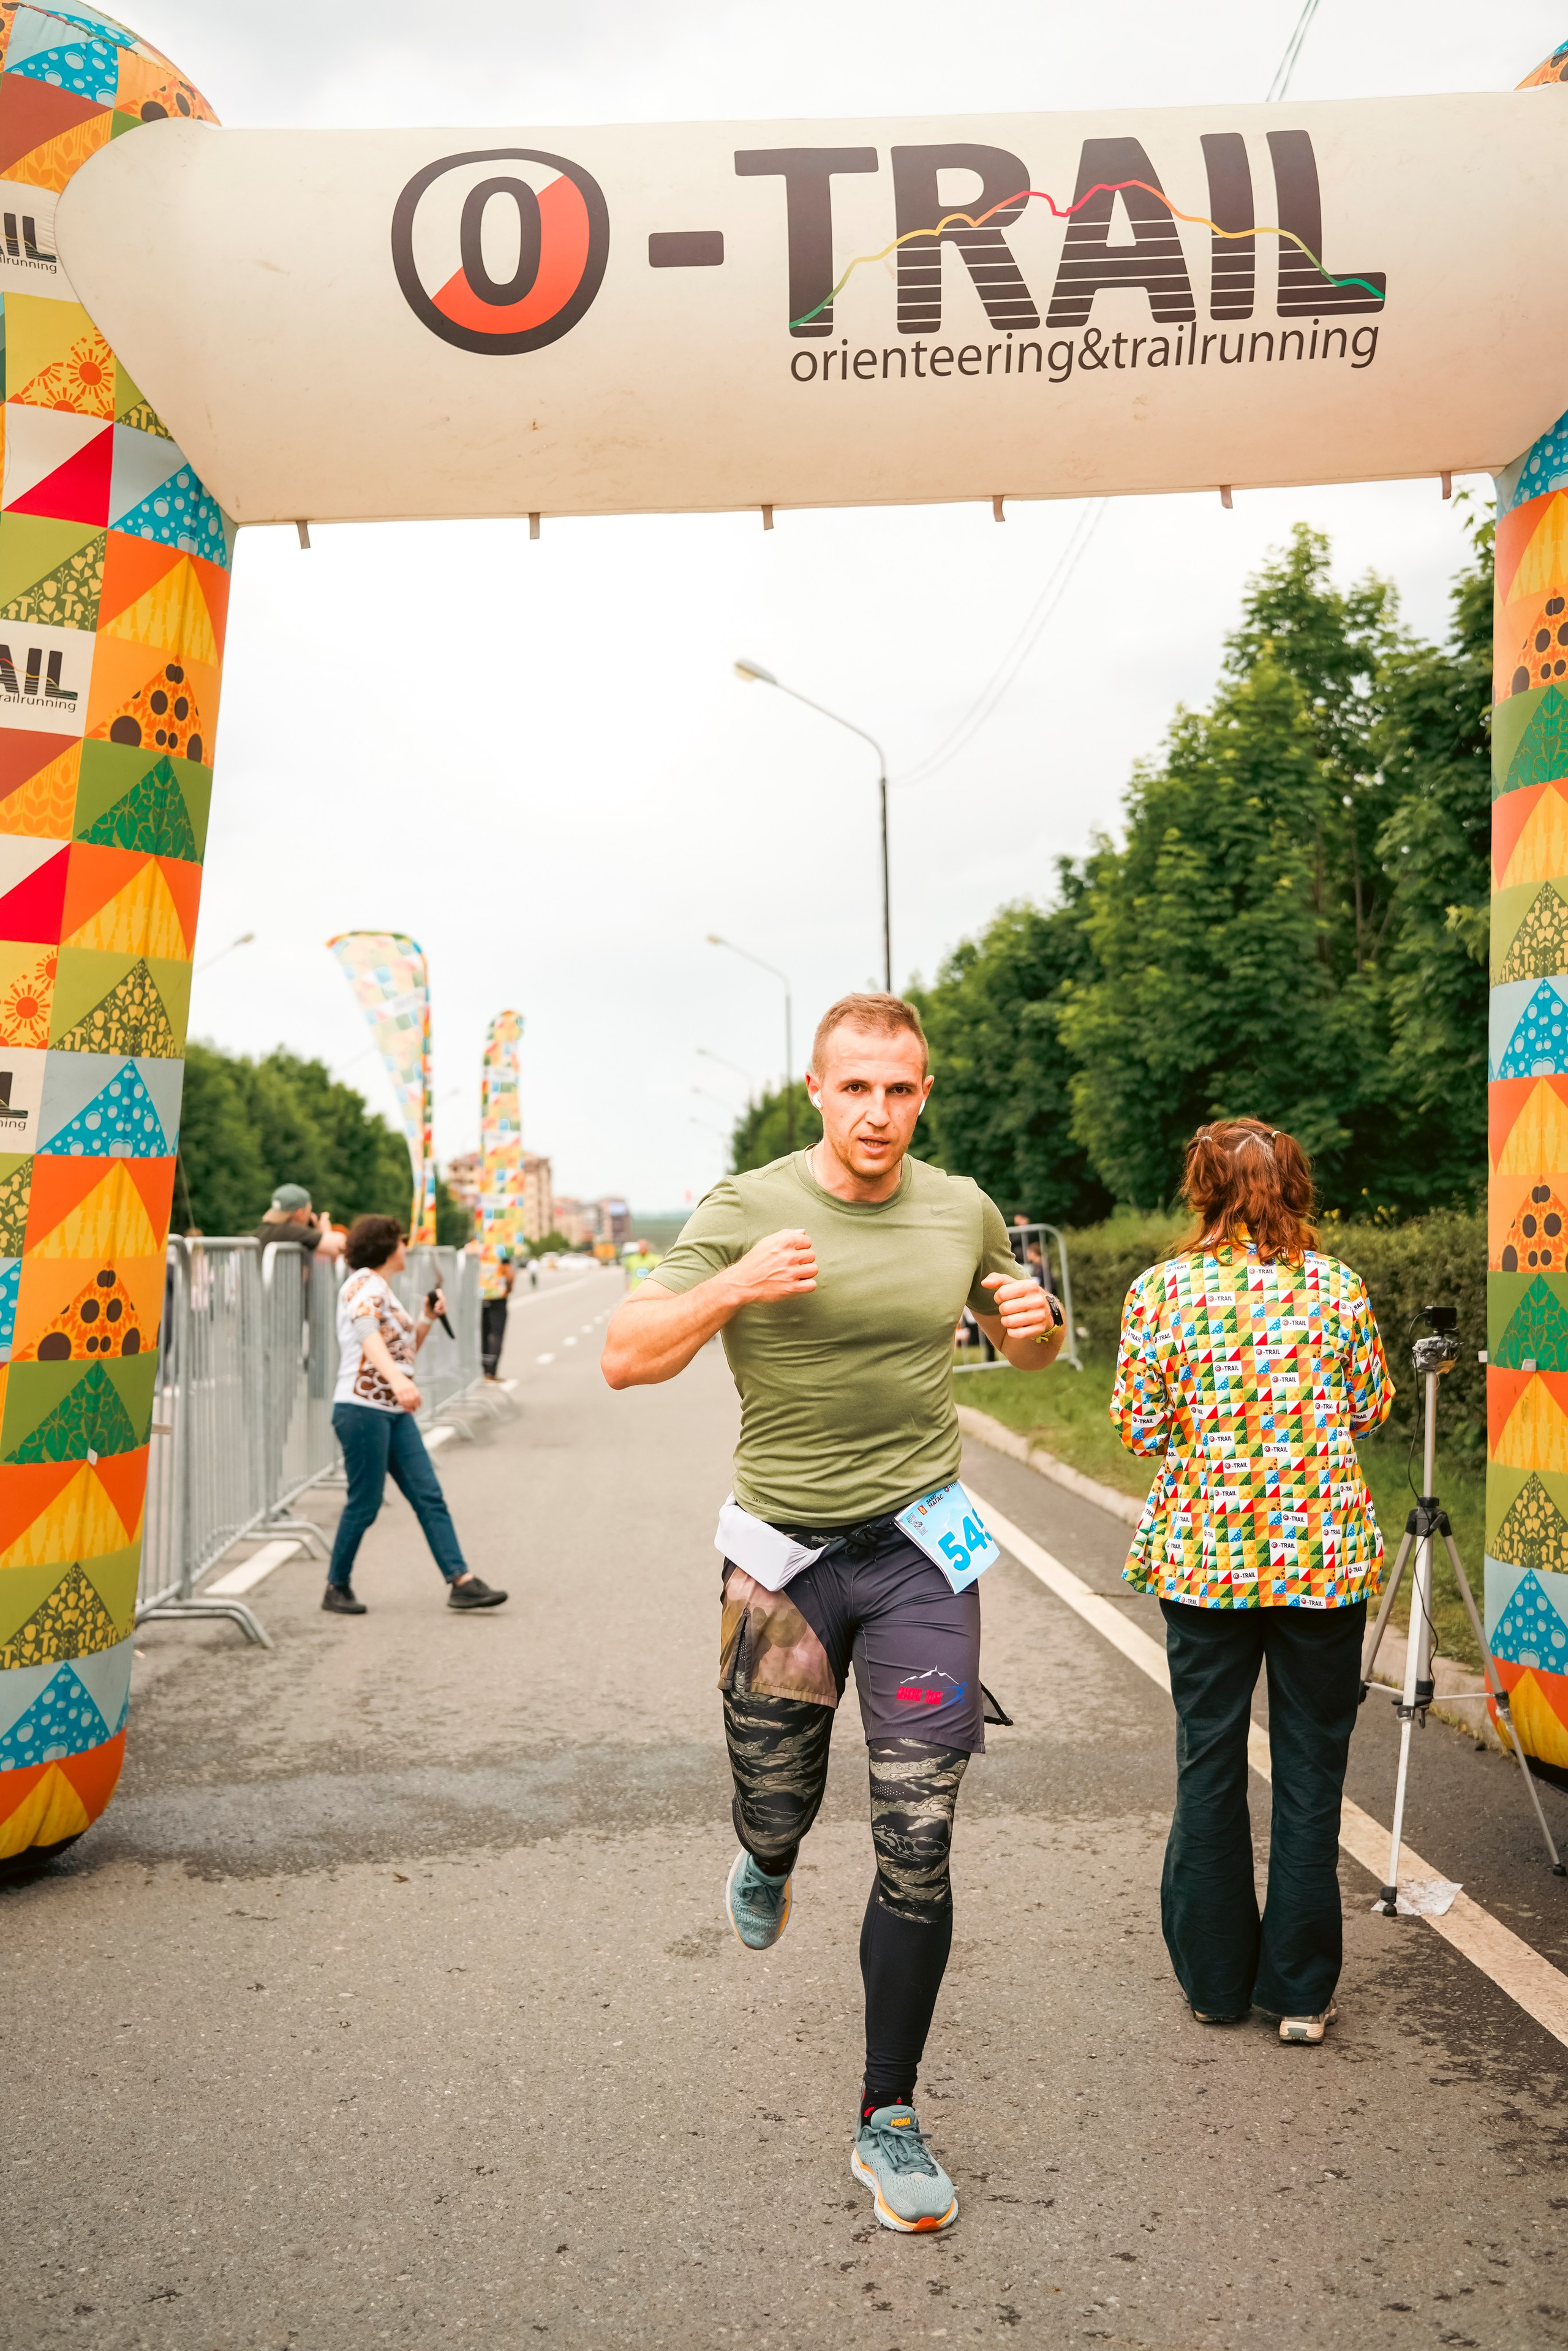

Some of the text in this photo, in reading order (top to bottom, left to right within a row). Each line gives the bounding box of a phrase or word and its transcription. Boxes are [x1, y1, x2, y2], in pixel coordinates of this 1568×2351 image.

[791, 319, 1379, 384] orienteering&trailrunning
[0, 644, 78, 701] AIL
[928, 1494, 944, 1509] МАГАС
[1301, 1598, 1323, 1606] O-TRAIL
[891, 2117, 911, 2127] HOKA
